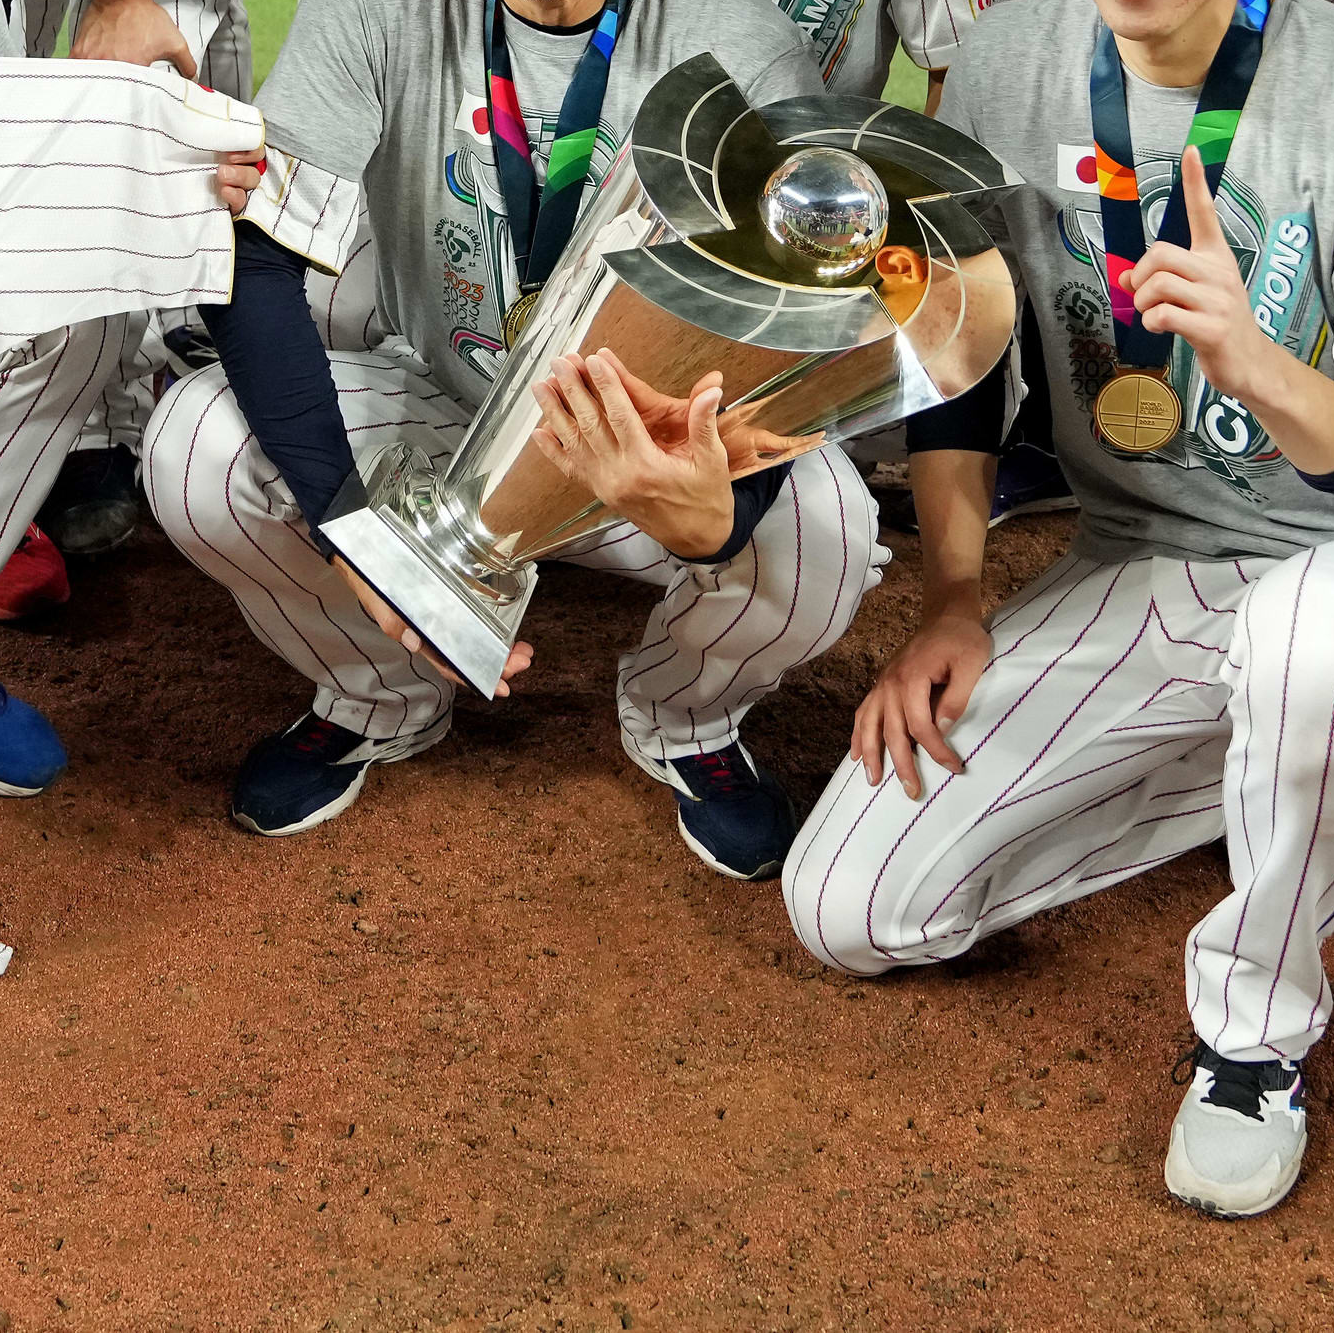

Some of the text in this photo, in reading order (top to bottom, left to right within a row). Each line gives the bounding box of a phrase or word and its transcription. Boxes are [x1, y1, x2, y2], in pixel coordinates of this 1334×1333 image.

[449, 220, 482, 258] BASEBALL
[444, 262, 485, 302] 2023
[508, 306, 523, 332] WORLD
[1054, 281, 1112, 338] WORLD BASEBALL CLASSIC
